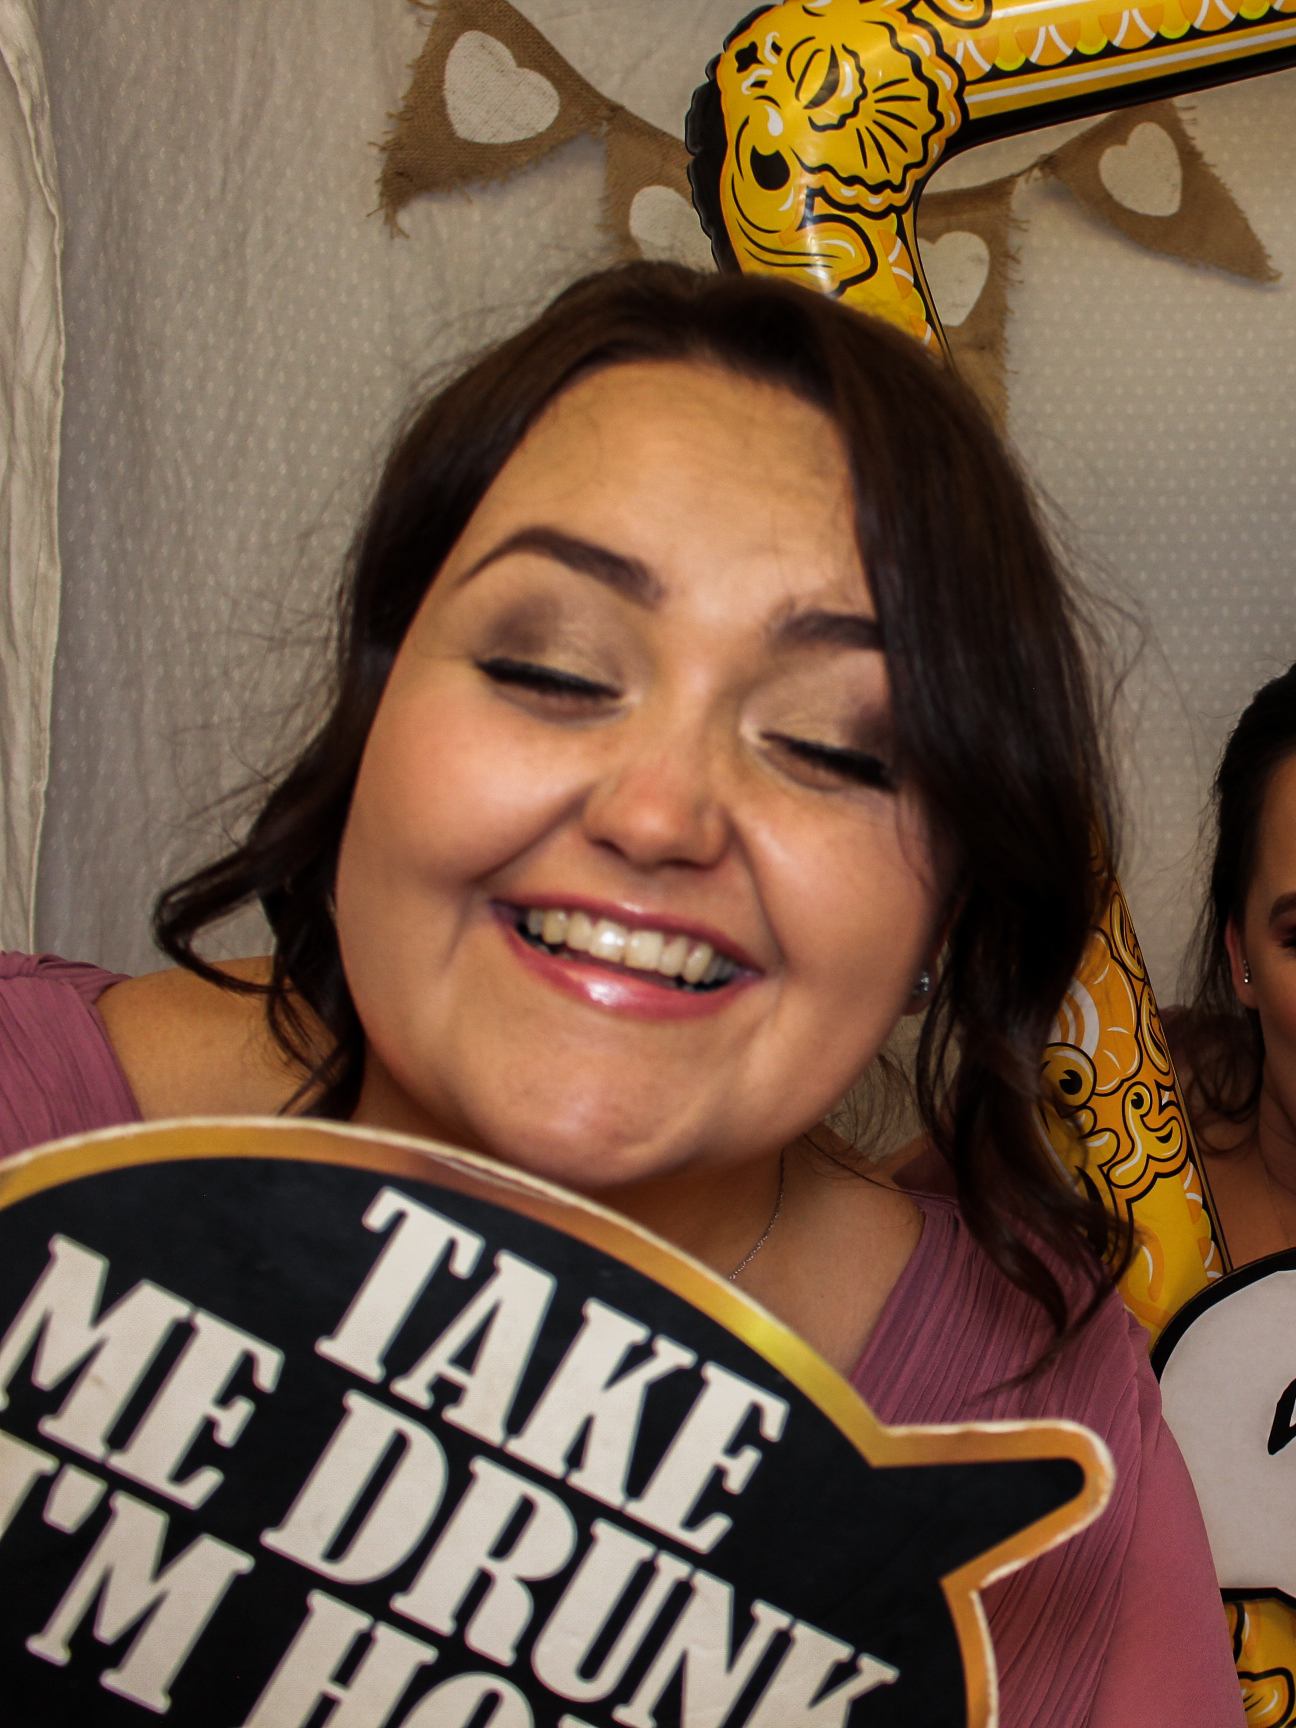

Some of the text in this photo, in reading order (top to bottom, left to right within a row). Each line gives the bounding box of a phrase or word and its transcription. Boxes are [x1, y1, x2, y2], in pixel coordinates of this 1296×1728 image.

[0, 1233, 284, 1510] ME
[260, 1389, 899, 1728] DRUNK
[315, 1186, 790, 1555] TAKE
